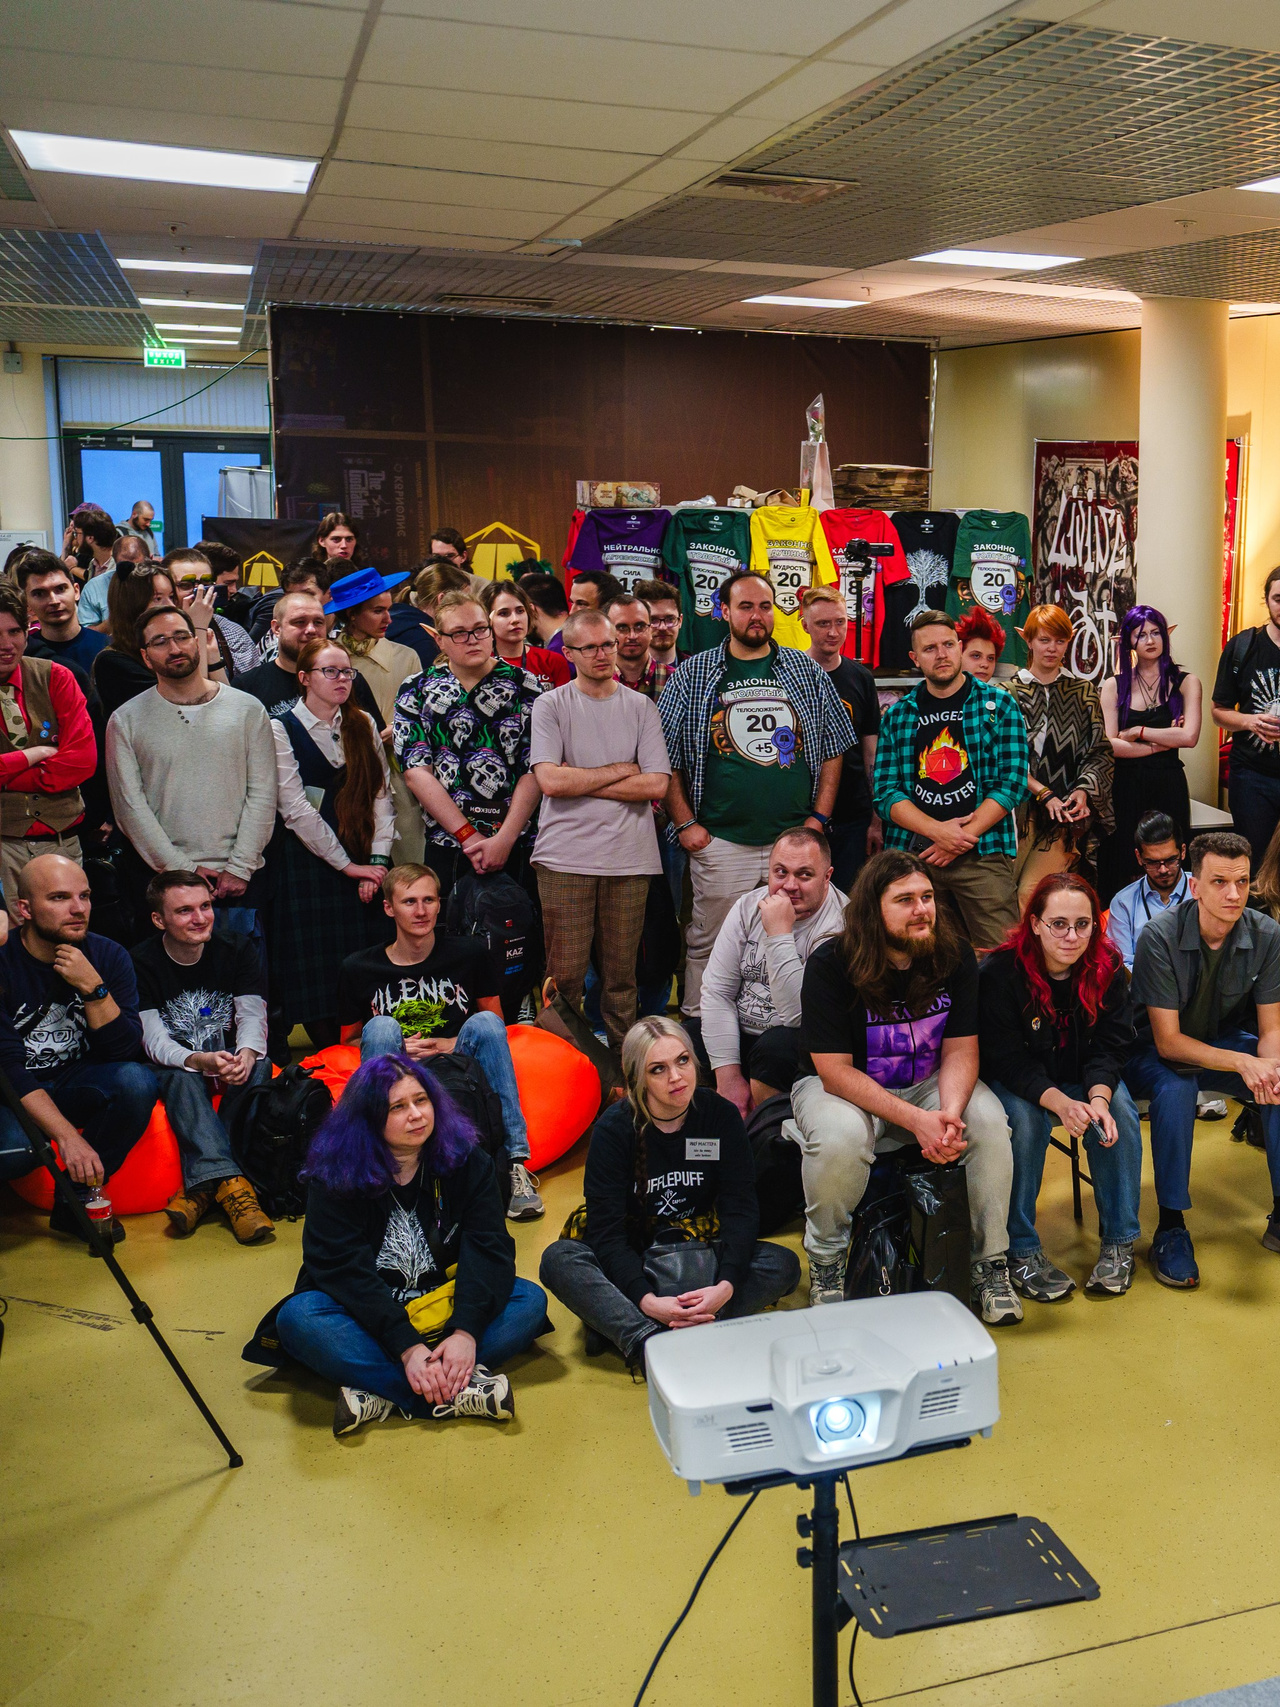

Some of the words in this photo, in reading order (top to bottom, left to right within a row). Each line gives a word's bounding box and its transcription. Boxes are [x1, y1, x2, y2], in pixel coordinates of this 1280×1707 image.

[603, 543, 661, 554] НЕЙТРАЛЬНО
[689, 542, 736, 556] ЗАКОННО
[767, 540, 813, 549] ЗАКОННО
[973, 544, 1015, 553] ЗАКОННО
[770, 549, 810, 558] ДУШНЫЙ
[622, 569, 642, 577] СИЛА
[773, 564, 807, 572] МУДРОСТЬ
[694, 573, 719, 590] 20
[777, 572, 802, 587] 20
[983, 573, 1005, 587] 20
[696, 597, 711, 607] +5
[781, 596, 795, 606] +5
[987, 594, 1000, 603] +5
[731, 688, 784, 698] ТОЛСТЫЙ
[746, 714, 777, 733] 20
[755, 742, 773, 753] +5
[915, 781, 976, 805] DISASTER
[469, 806, 501, 814] РОЛЕКОН
[506, 947, 524, 958] KAZ
